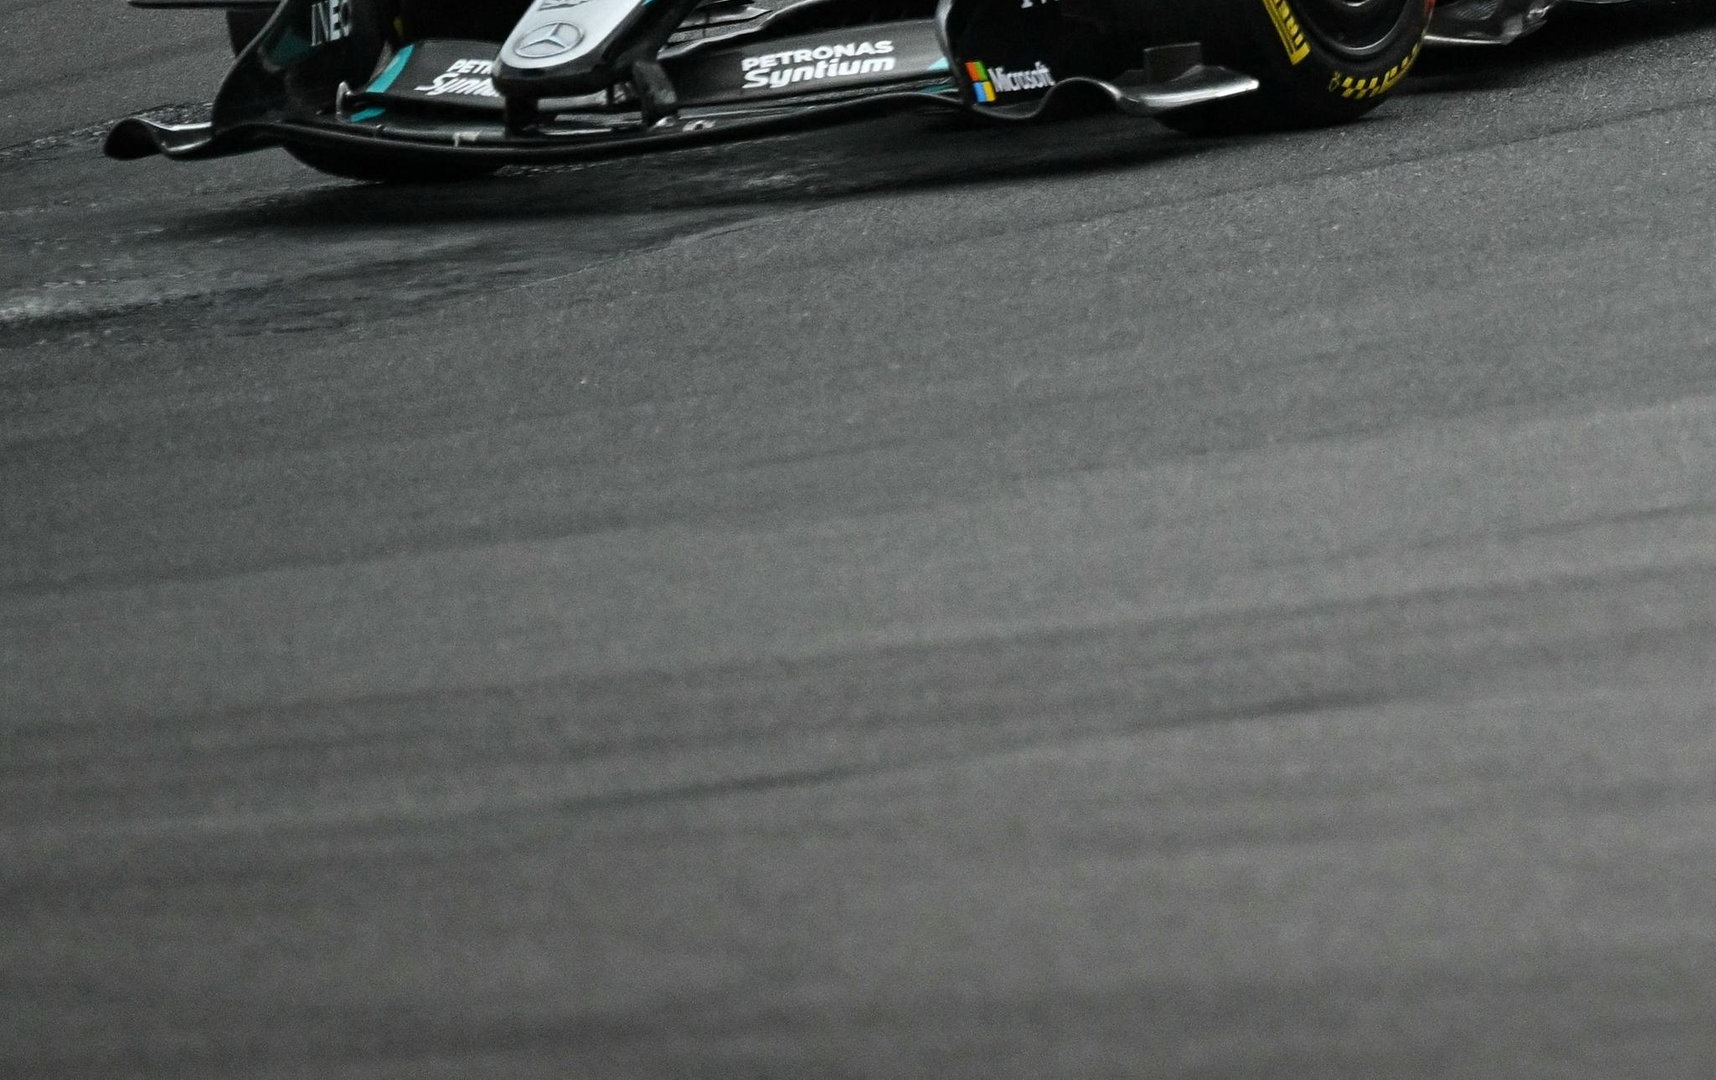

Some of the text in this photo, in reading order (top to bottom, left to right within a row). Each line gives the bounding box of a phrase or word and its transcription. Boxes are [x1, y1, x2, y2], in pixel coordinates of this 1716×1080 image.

[742, 39, 895, 72] PETRONAS
[742, 55, 897, 90] Syntium
[990, 60, 1057, 93] Microsoft
